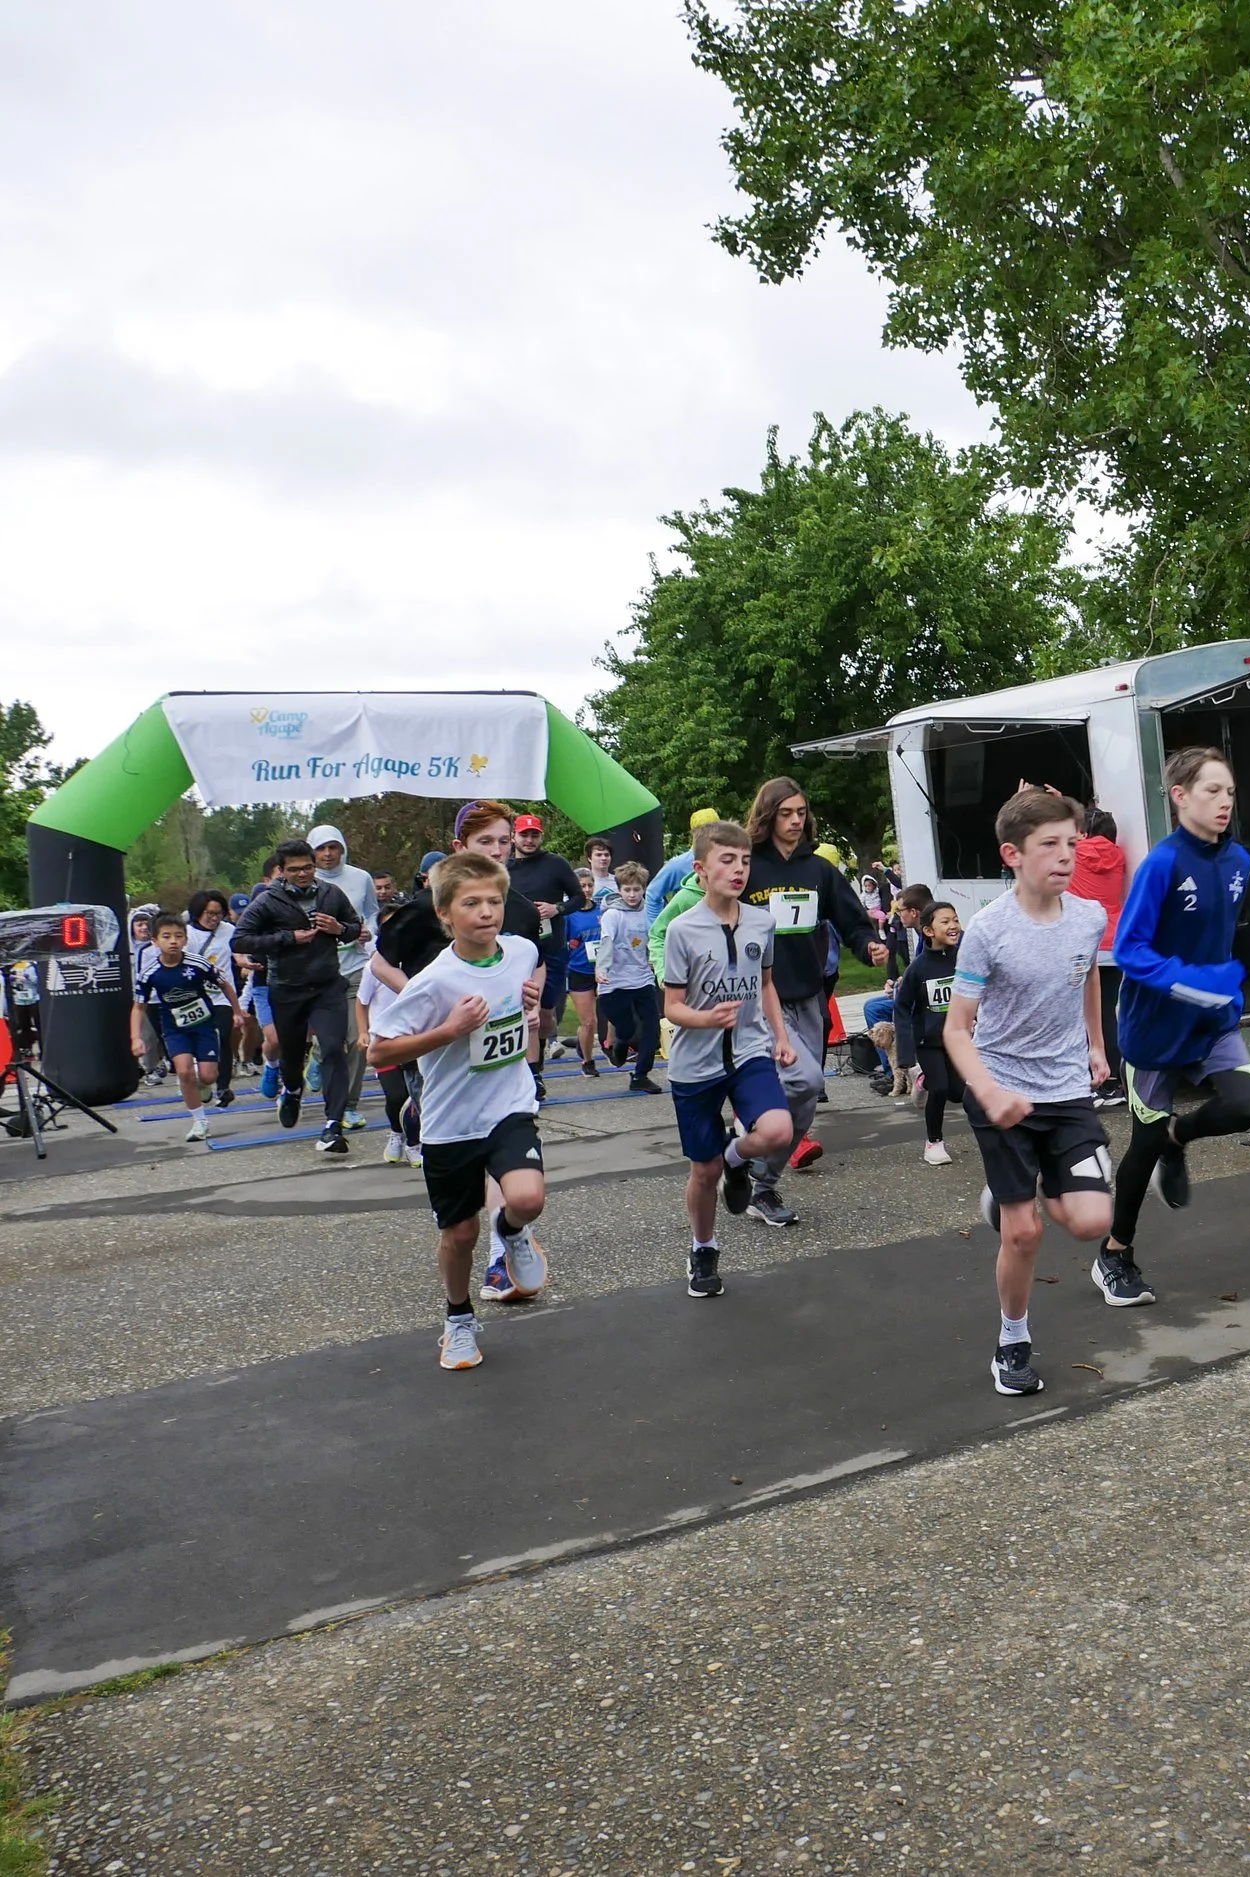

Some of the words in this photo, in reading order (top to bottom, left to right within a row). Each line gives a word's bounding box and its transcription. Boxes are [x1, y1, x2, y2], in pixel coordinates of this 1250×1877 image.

[269, 710, 308, 725] Camp
[251, 759, 301, 782] Run
[307, 757, 346, 778] For
[353, 753, 421, 778] Agape
[427, 756, 461, 778] 5K
[1183, 893, 1198, 912] 2
[791, 905, 800, 925] 7
[64, 916, 86, 946] 0
[49, 989, 84, 997] RUNNING
[87, 986, 122, 994] COMPANY
[701, 975, 758, 997] QATAR
[714, 991, 758, 1003] AIRWAYS
[180, 1007, 205, 1025] 293
[483, 1024, 524, 1061] 257
